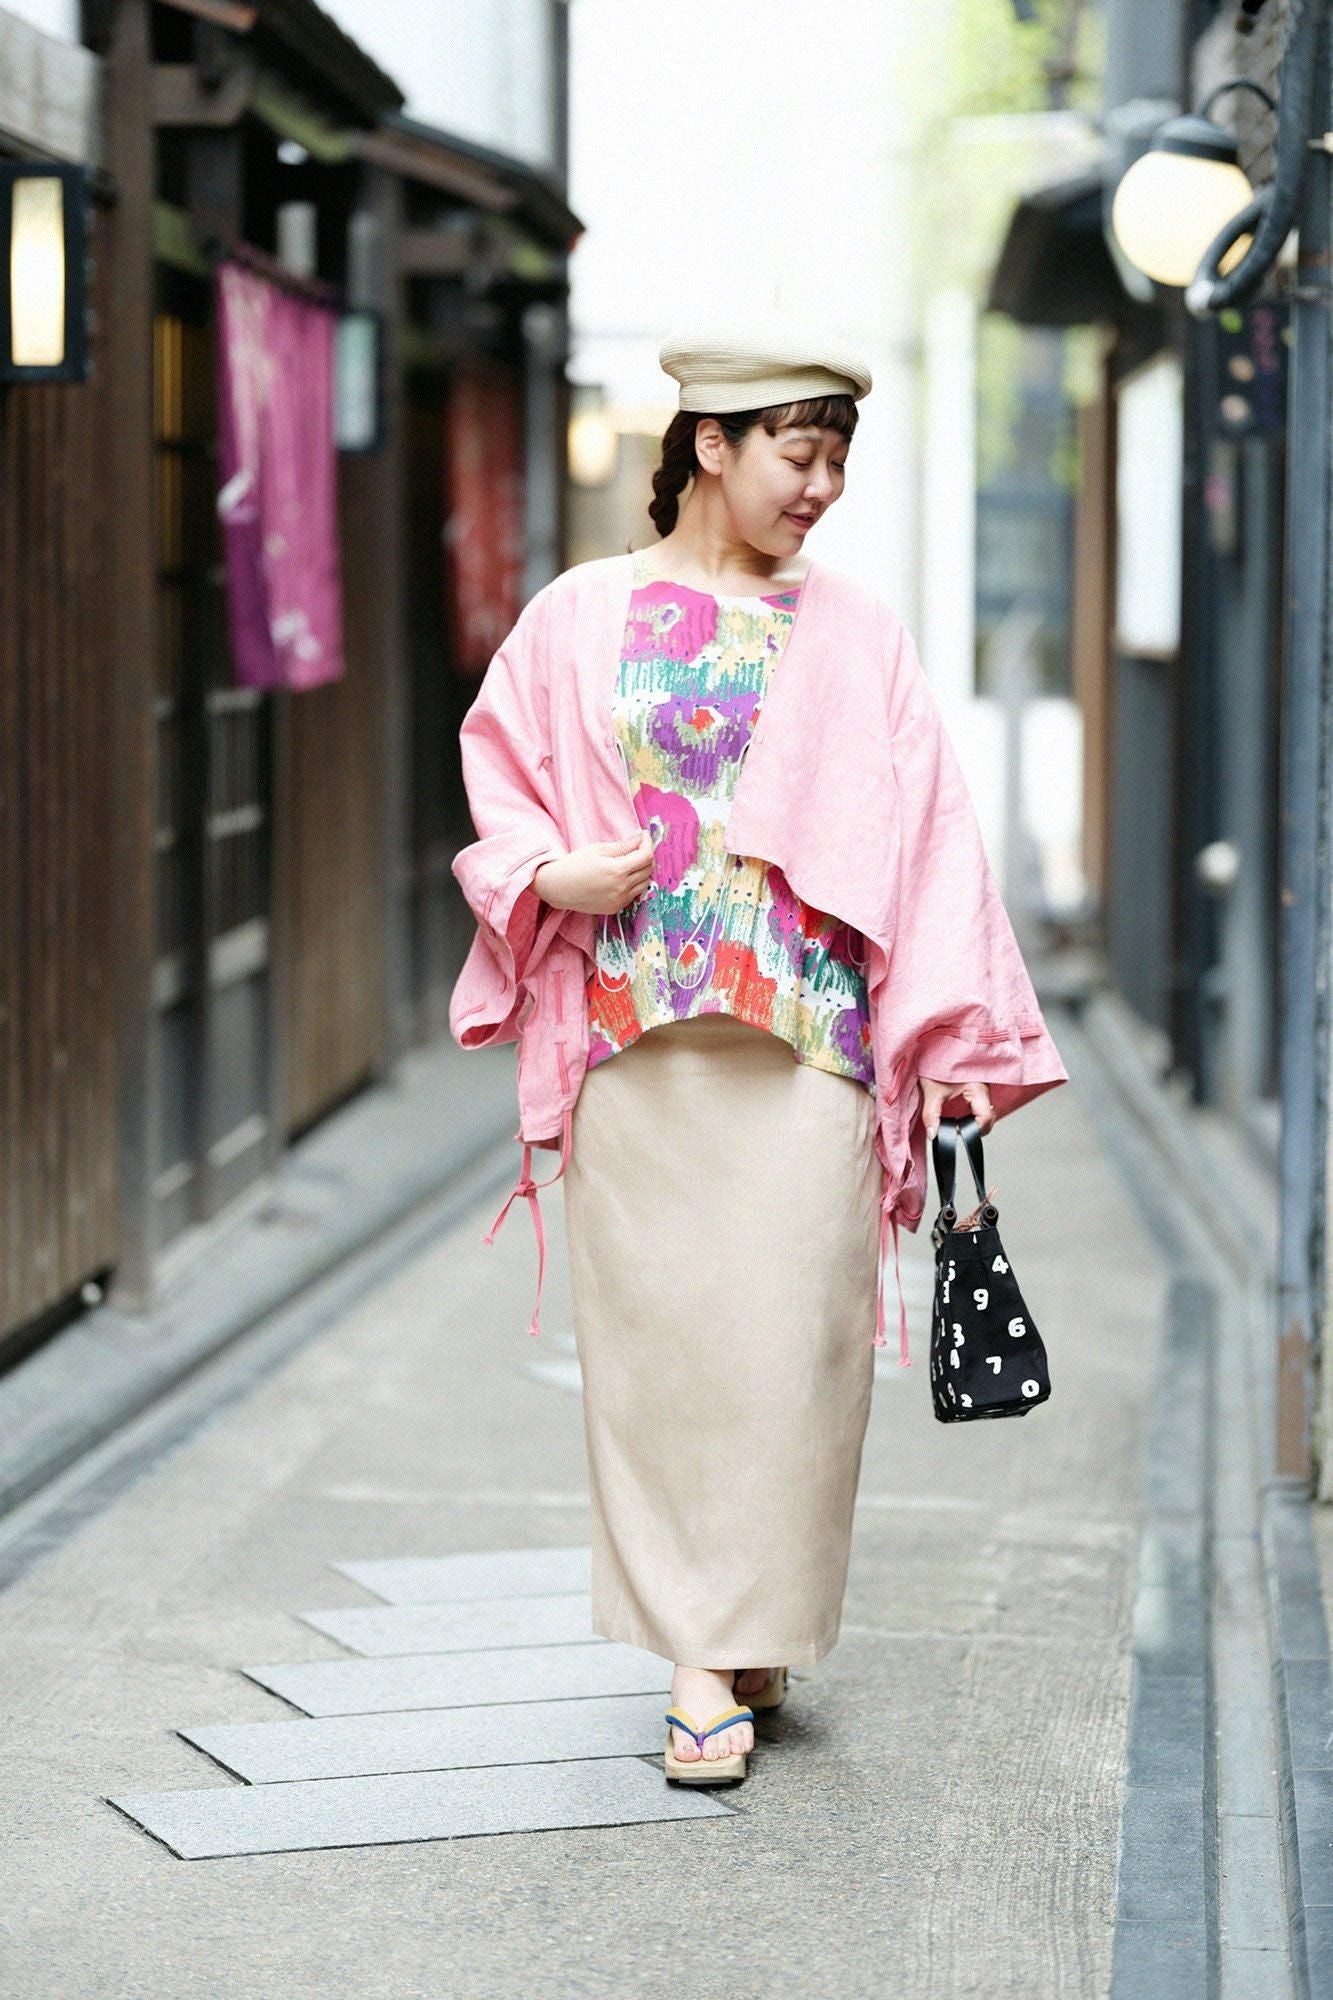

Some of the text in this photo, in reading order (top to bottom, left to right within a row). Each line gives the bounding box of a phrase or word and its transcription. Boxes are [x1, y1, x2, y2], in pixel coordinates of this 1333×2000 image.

[991, 1254, 1010, 1275] 4
[973, 1288, 989, 1311] 9
[952, 1322, 966, 1348] 3
[1007, 1316, 1027, 1338] 6
[985, 1355, 1003, 1375] 7
[1020, 1379, 1040, 1398] 0
